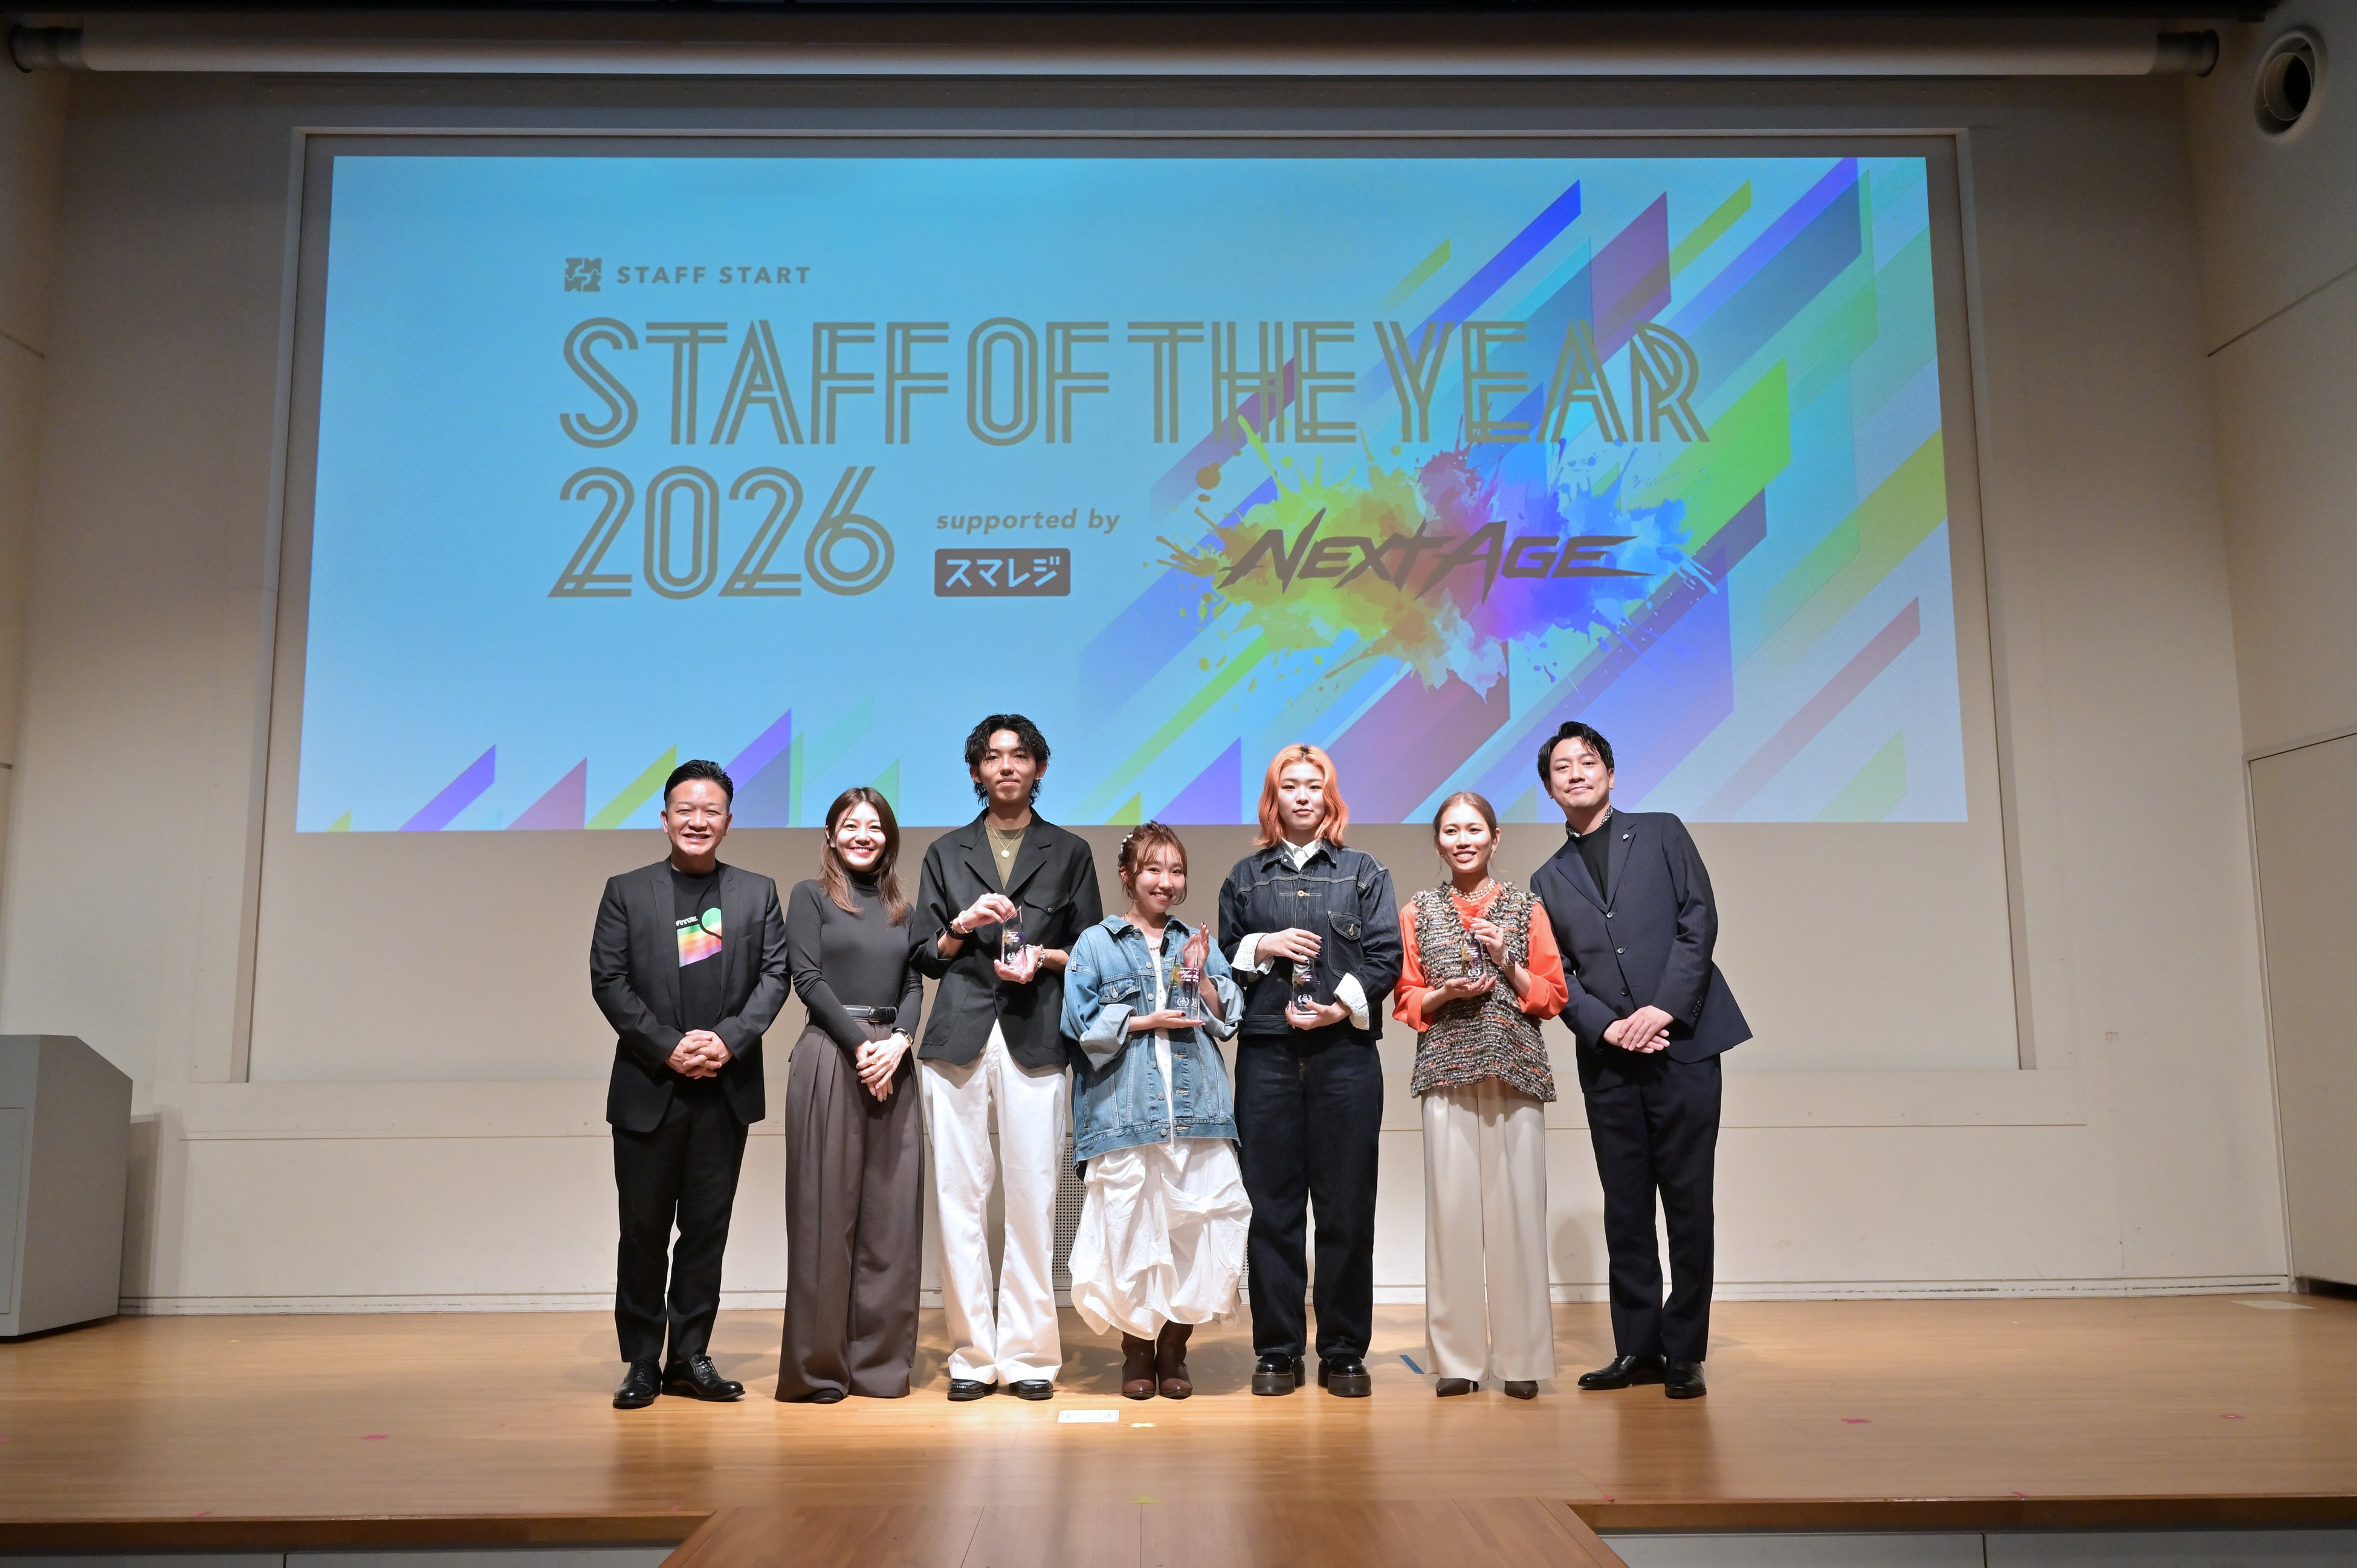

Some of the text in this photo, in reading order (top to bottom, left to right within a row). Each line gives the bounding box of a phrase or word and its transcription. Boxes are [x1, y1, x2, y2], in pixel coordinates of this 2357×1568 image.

[616, 266, 811, 285] STAFF START
[559, 317, 1710, 448] STAFF OF THE YEAR
[548, 465, 895, 600] 2026
[936, 508, 1121, 535] supported by
[945, 555, 1062, 588] スマレジ
